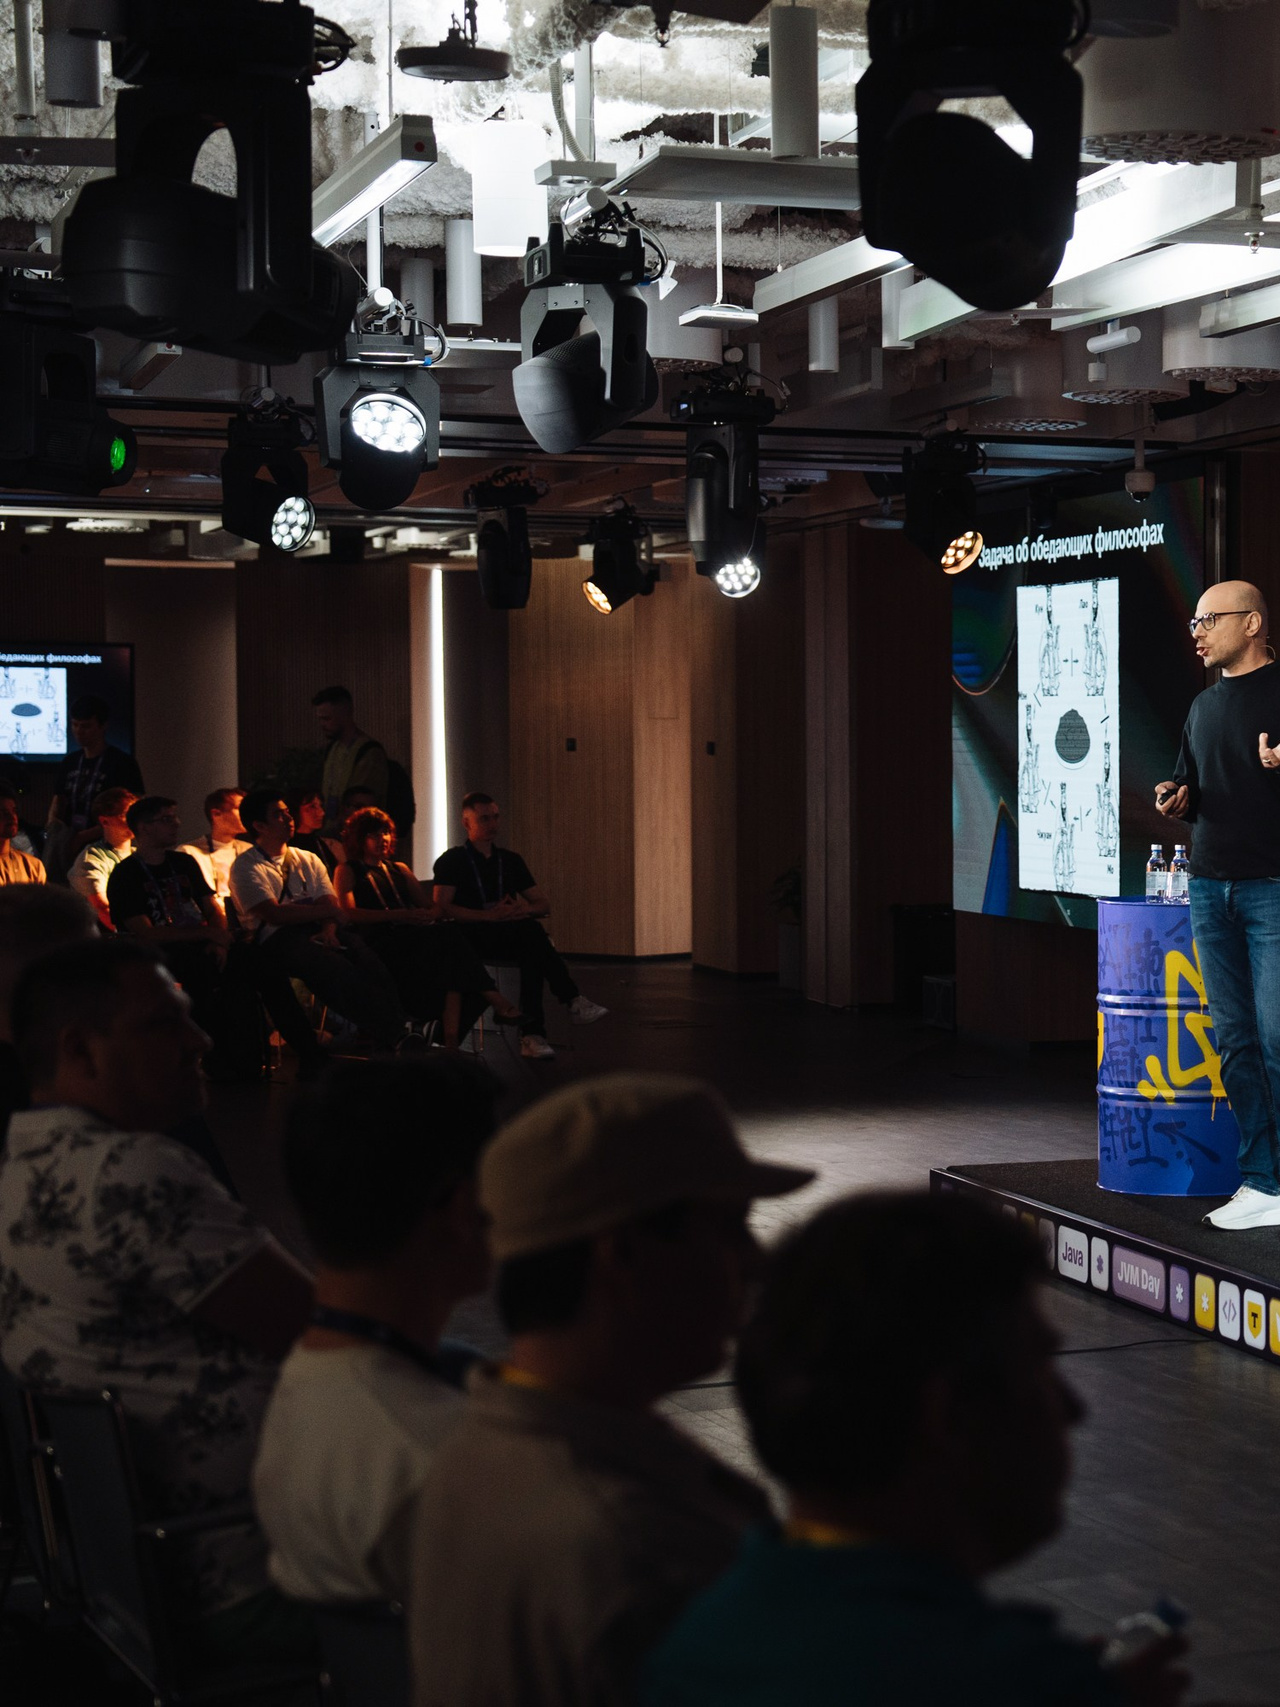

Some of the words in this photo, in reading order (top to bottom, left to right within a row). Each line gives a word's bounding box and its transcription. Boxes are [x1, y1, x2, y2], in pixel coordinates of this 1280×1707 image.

[978, 544, 1014, 571] Задача
[1016, 536, 1029, 564] об
[1031, 534, 1093, 563] обедающих
[1095, 519, 1164, 558] философах
[46, 653, 101, 664] философах
[1062, 1241, 1084, 1267] Java
[1117, 1260, 1140, 1287] JVM
[1142, 1272, 1160, 1299] Day
